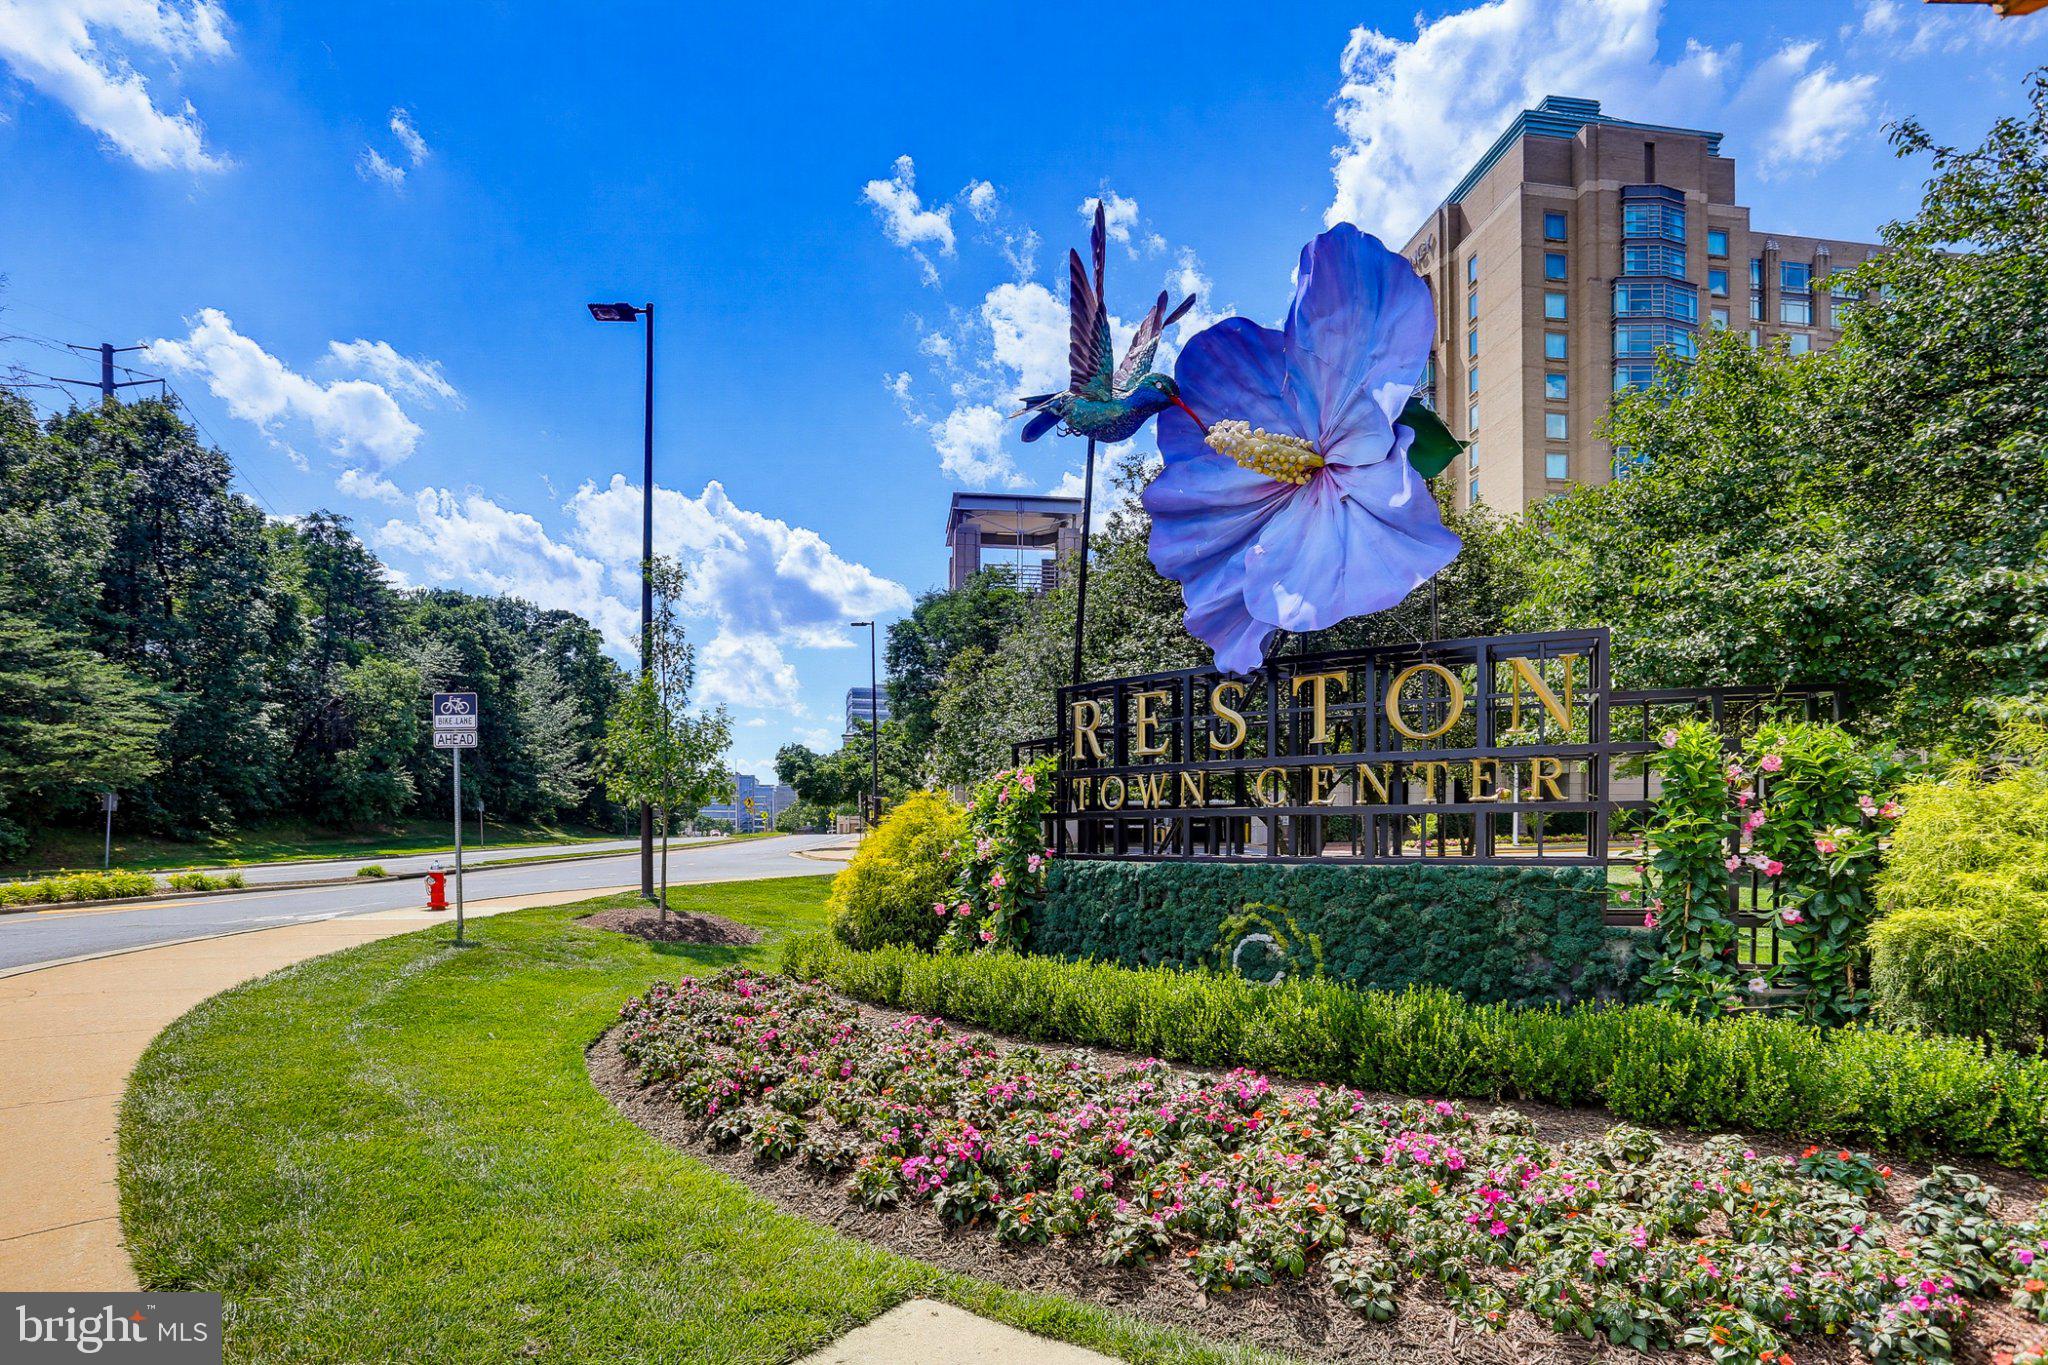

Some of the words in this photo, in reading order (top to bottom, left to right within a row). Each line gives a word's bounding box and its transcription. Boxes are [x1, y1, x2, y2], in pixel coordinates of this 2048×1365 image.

[438, 717, 452, 725] BIKE
[456, 717, 472, 725] LANE
[1072, 653, 1579, 760] RESTON
[437, 734, 474, 745] AHEAD
[1073, 771, 1206, 811] TOWN
[1256, 757, 1569, 806] CENTER
